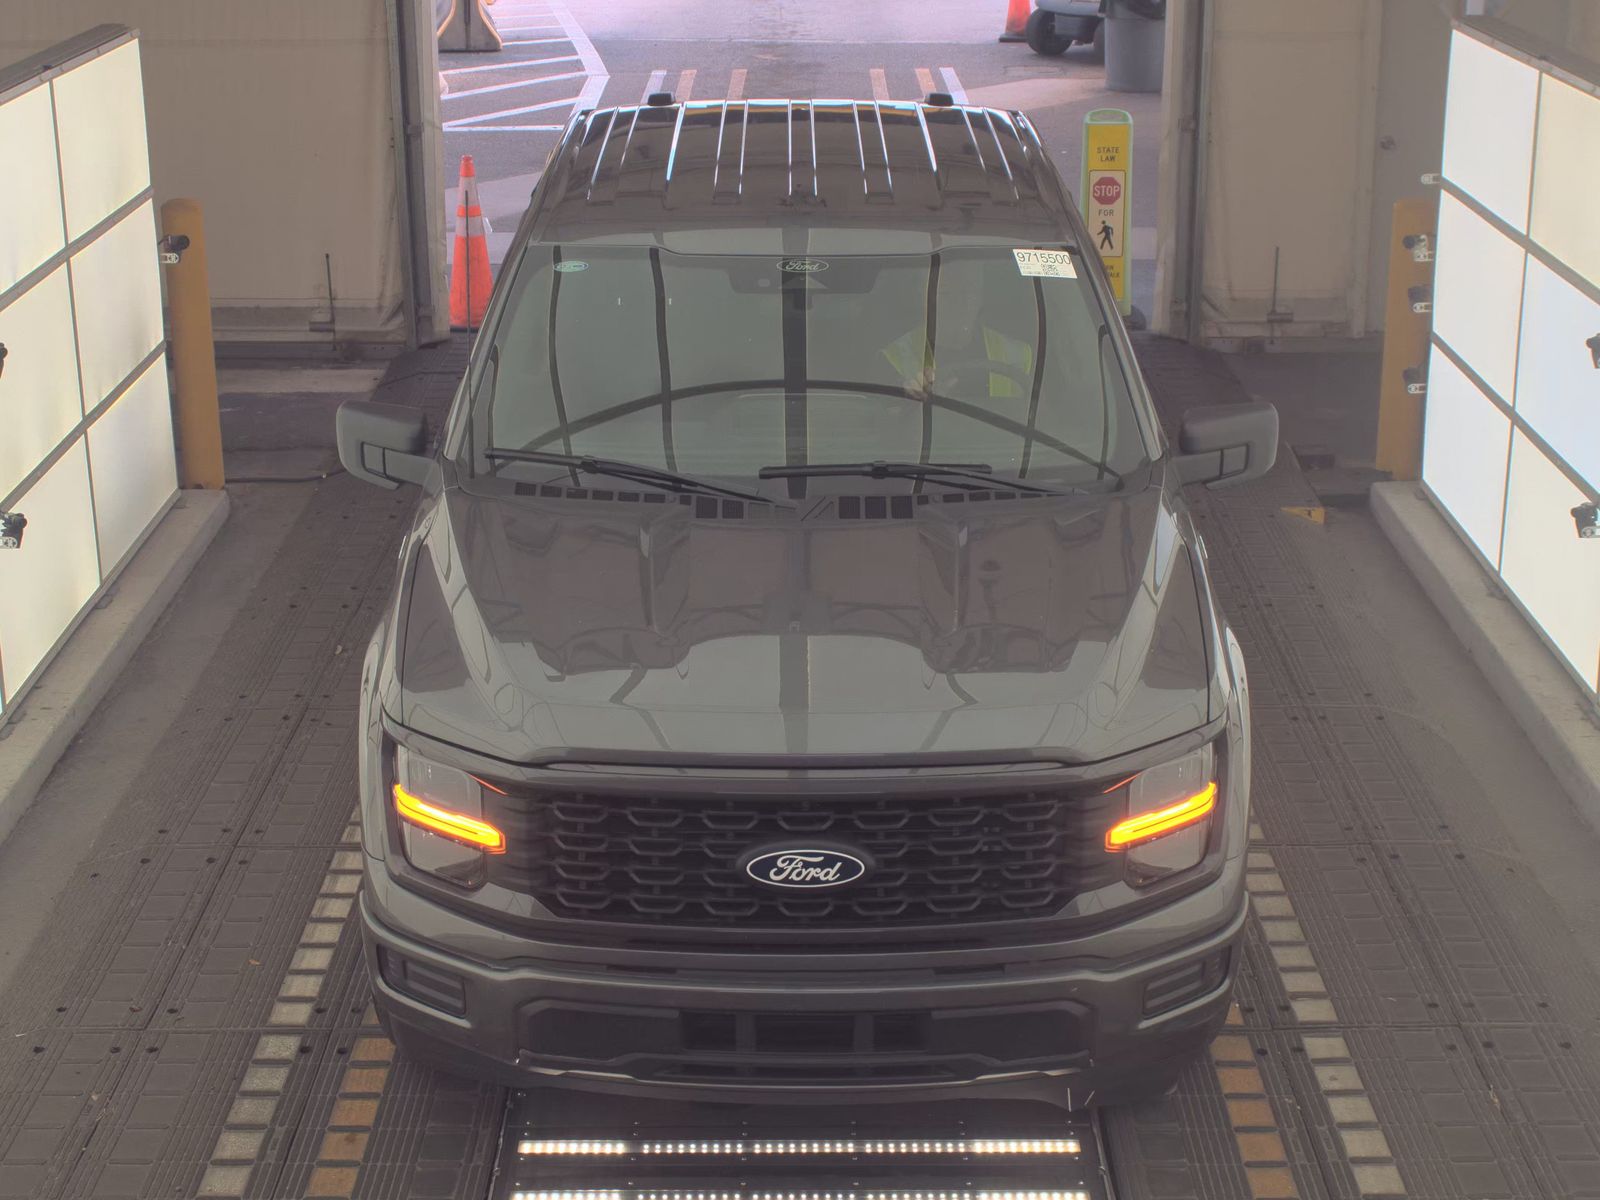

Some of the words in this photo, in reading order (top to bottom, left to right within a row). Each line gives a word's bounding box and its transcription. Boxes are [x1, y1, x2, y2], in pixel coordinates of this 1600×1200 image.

[1096, 146, 1120, 154] STATE
[1094, 185, 1120, 197] STOP
[1098, 208, 1114, 216] FOR
[1016, 251, 1071, 265] 9715500
[769, 855, 843, 881] Ford
